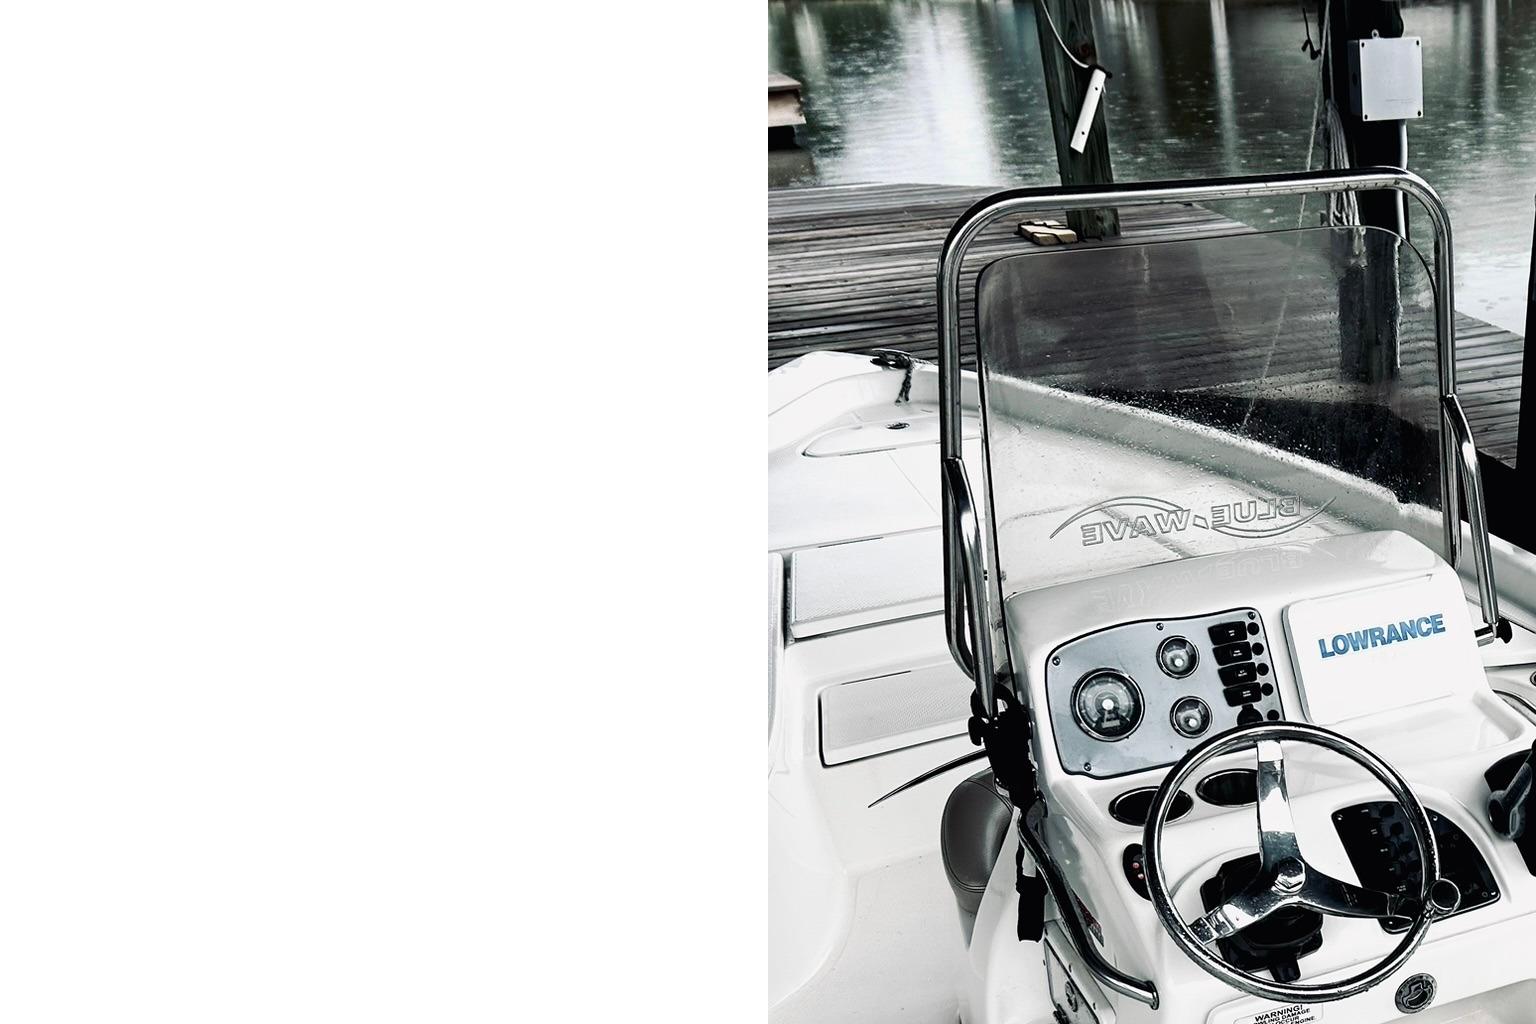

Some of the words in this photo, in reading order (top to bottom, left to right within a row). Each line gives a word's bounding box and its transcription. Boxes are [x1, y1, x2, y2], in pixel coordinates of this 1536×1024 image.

[1318, 613, 1446, 659] LOWRANCE
[1254, 1004, 1303, 1022] WARNING!
[1281, 1008, 1311, 1020] DAMAGE
